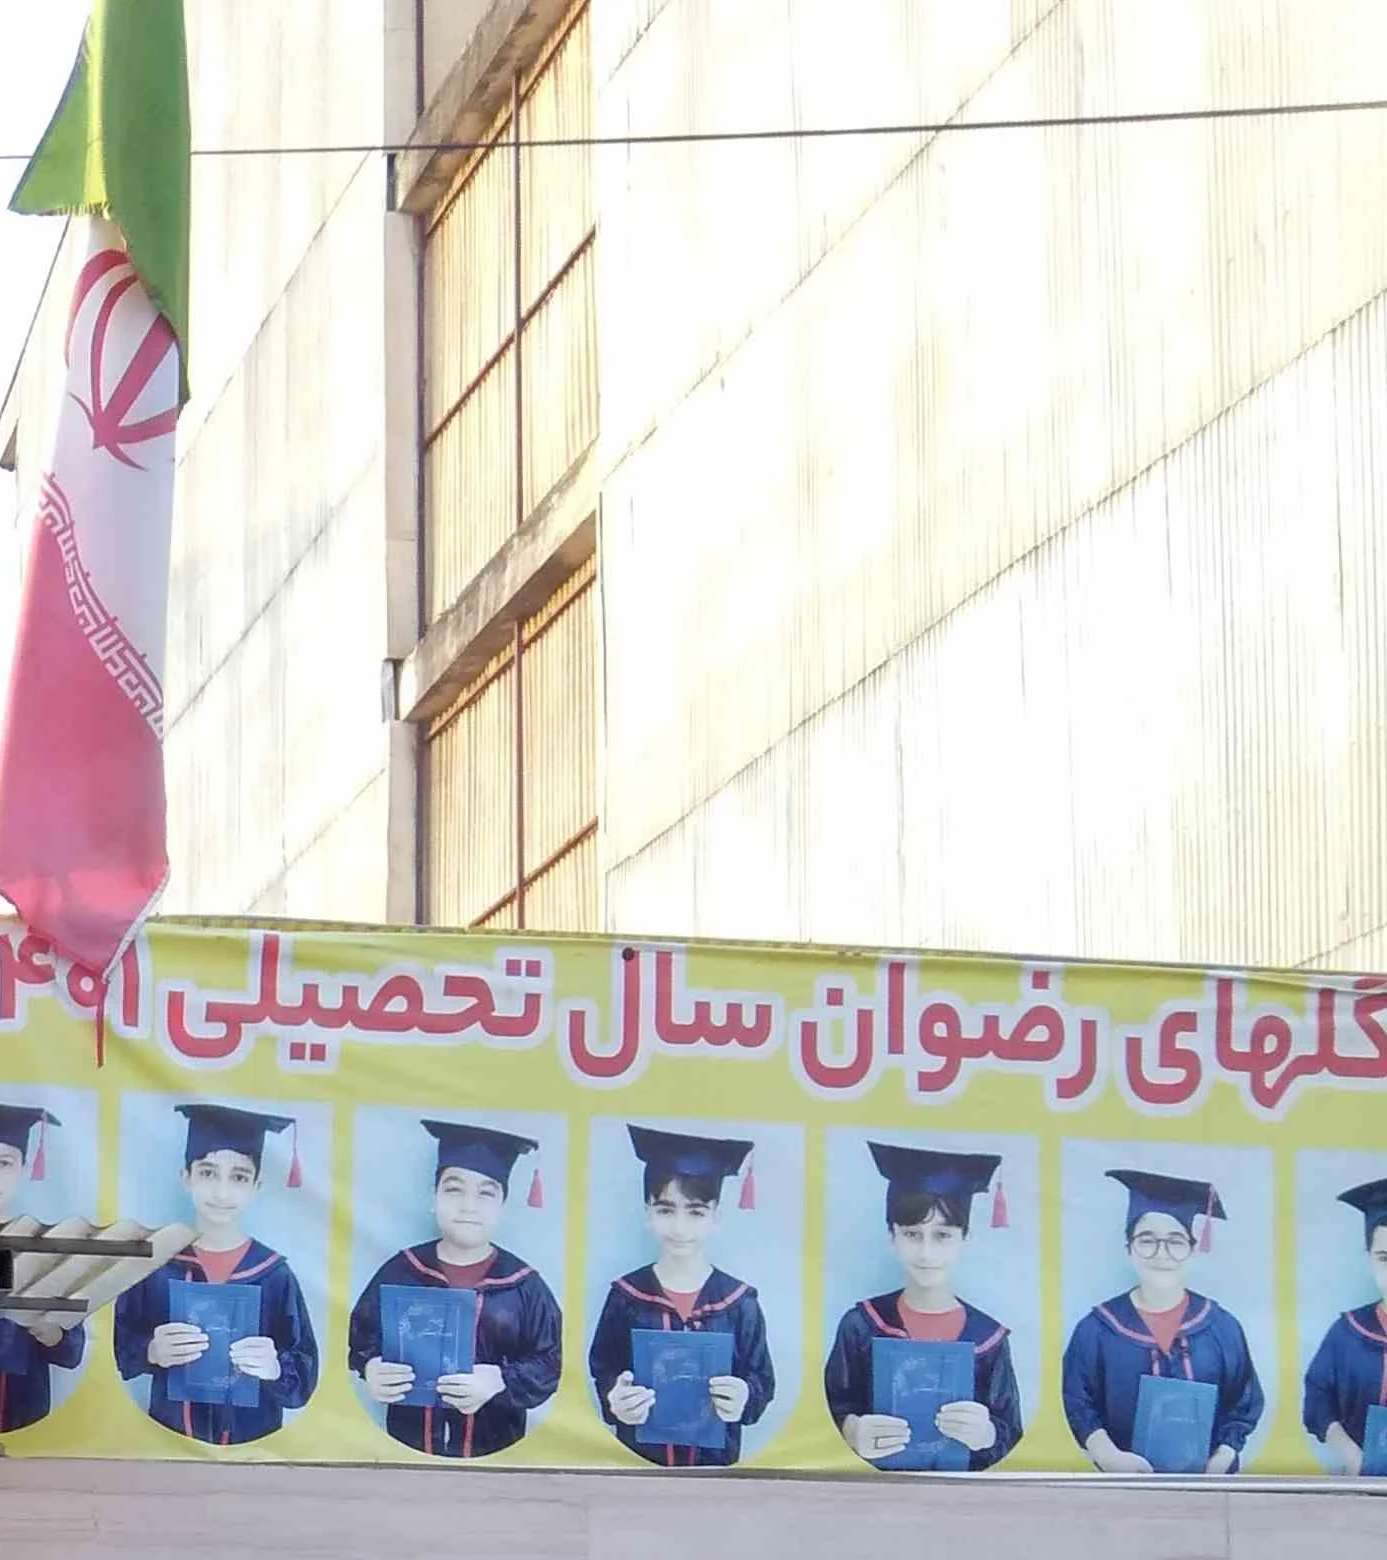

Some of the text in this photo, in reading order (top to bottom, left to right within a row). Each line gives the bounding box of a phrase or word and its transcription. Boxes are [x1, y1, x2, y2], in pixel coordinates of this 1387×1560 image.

[166, 933, 543, 1063] تحصیلی
[568, 949, 773, 1079] سال
[800, 961, 1099, 1100] رضوان
